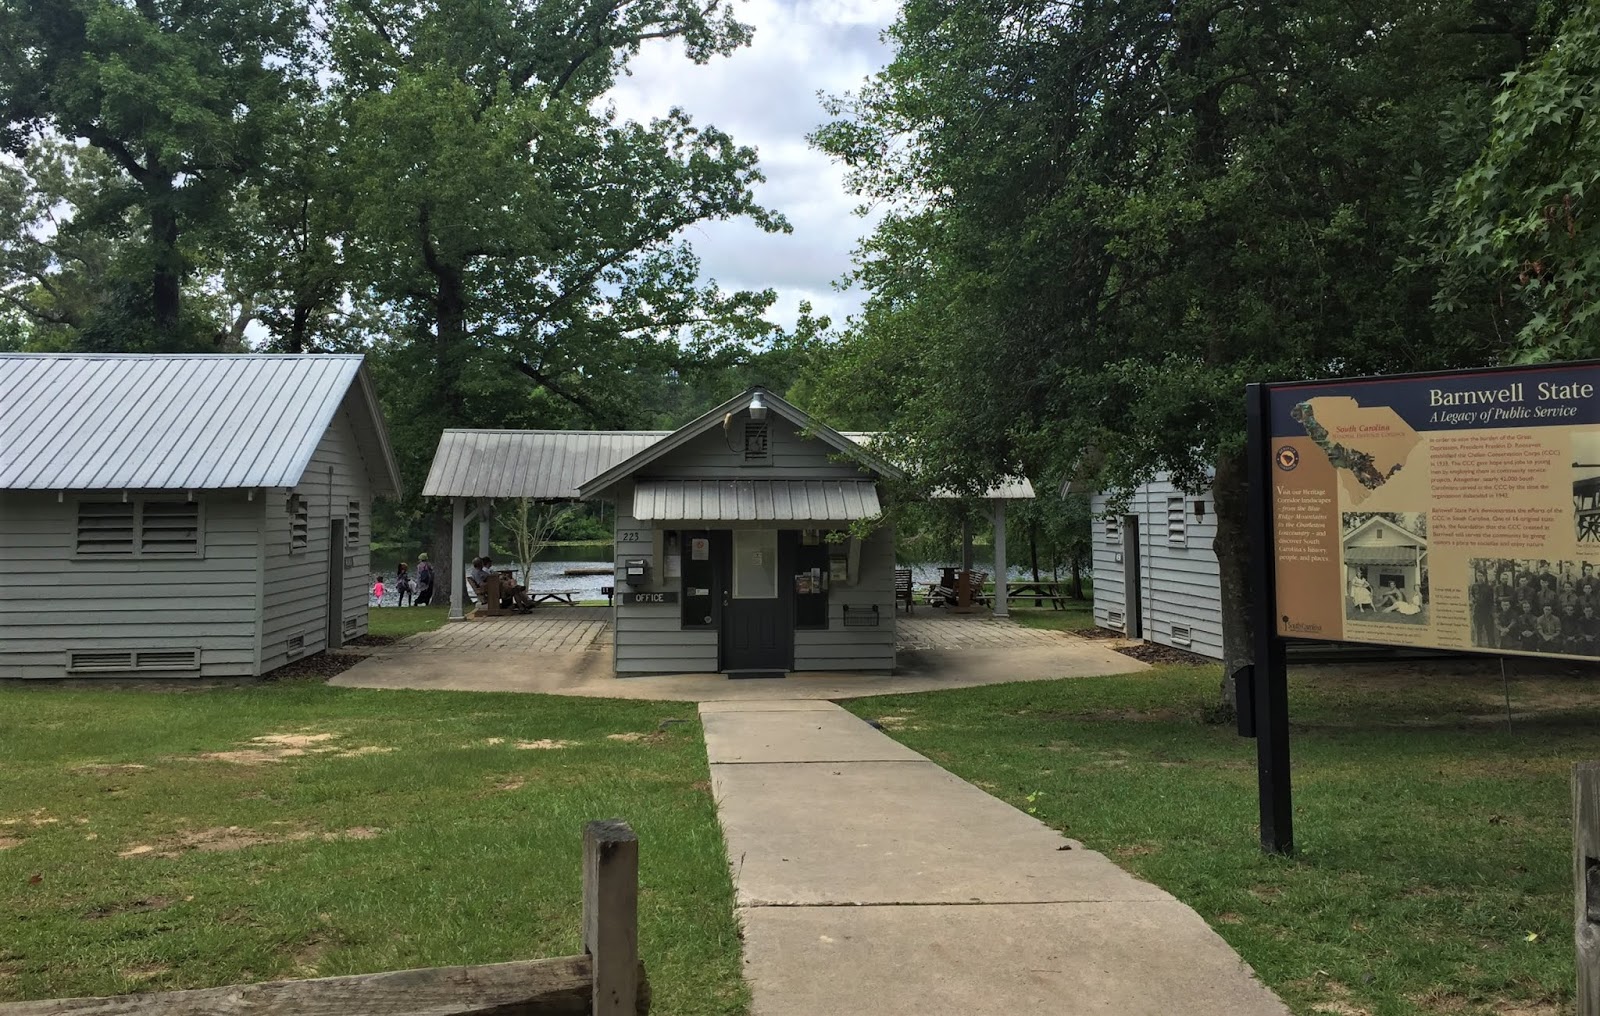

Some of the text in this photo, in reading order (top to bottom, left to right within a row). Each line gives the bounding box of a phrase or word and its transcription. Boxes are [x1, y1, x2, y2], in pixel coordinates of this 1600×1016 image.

[1429, 382, 1594, 406] Barnwell State
[1429, 405, 1577, 424] A Legacy of Public Service
[1336, 424, 1390, 433] South Carolina
[623, 532, 639, 541] 223
[635, 593, 664, 602] OFFICE
